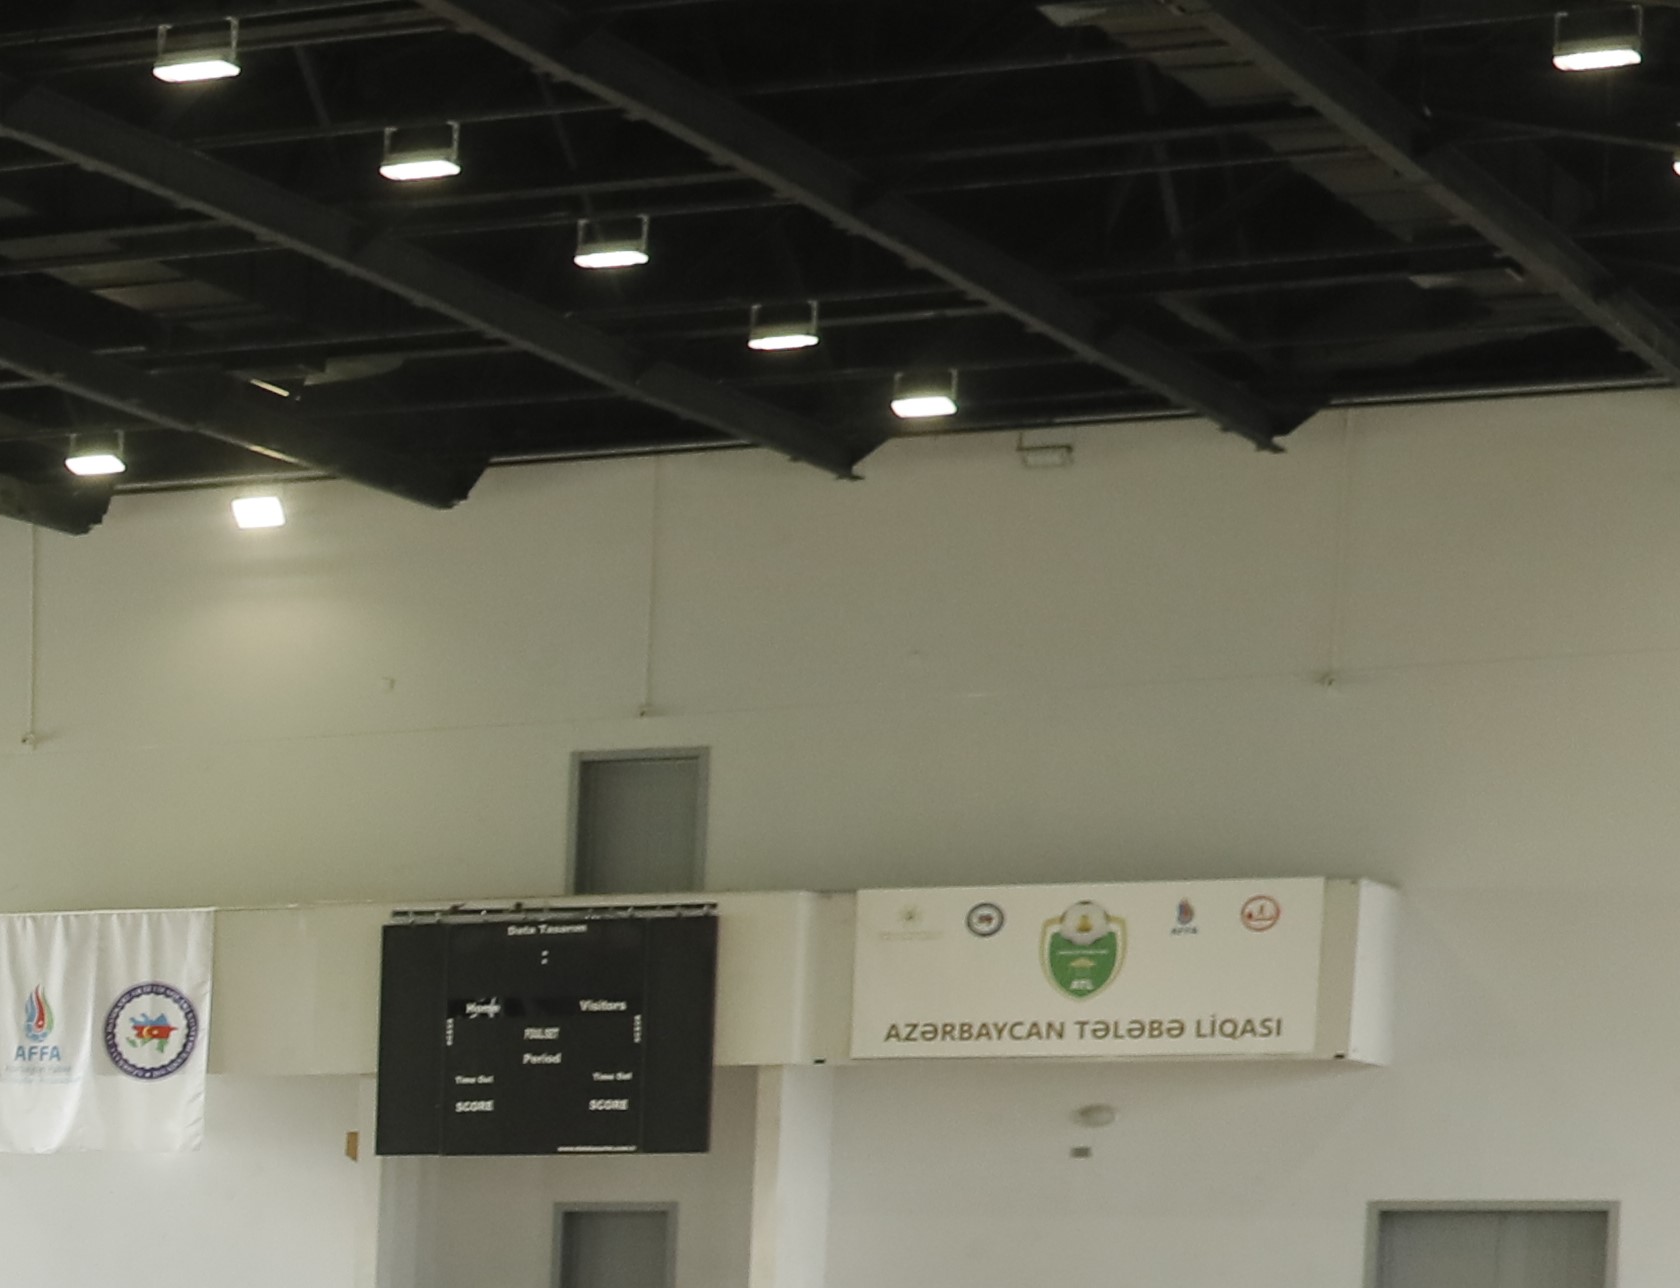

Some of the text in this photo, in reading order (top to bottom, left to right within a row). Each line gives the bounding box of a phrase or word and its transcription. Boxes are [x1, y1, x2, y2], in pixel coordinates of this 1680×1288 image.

[580, 1000, 627, 1011] Visitors
[885, 1014, 1282, 1042] AZƏRBAYCAN TƏLƏBƏ LİQASI
[14, 1046, 61, 1061] AFFA
[523, 1053, 561, 1064] Period
[456, 1101, 494, 1112] SCORE
[589, 1100, 628, 1110] SCORE
